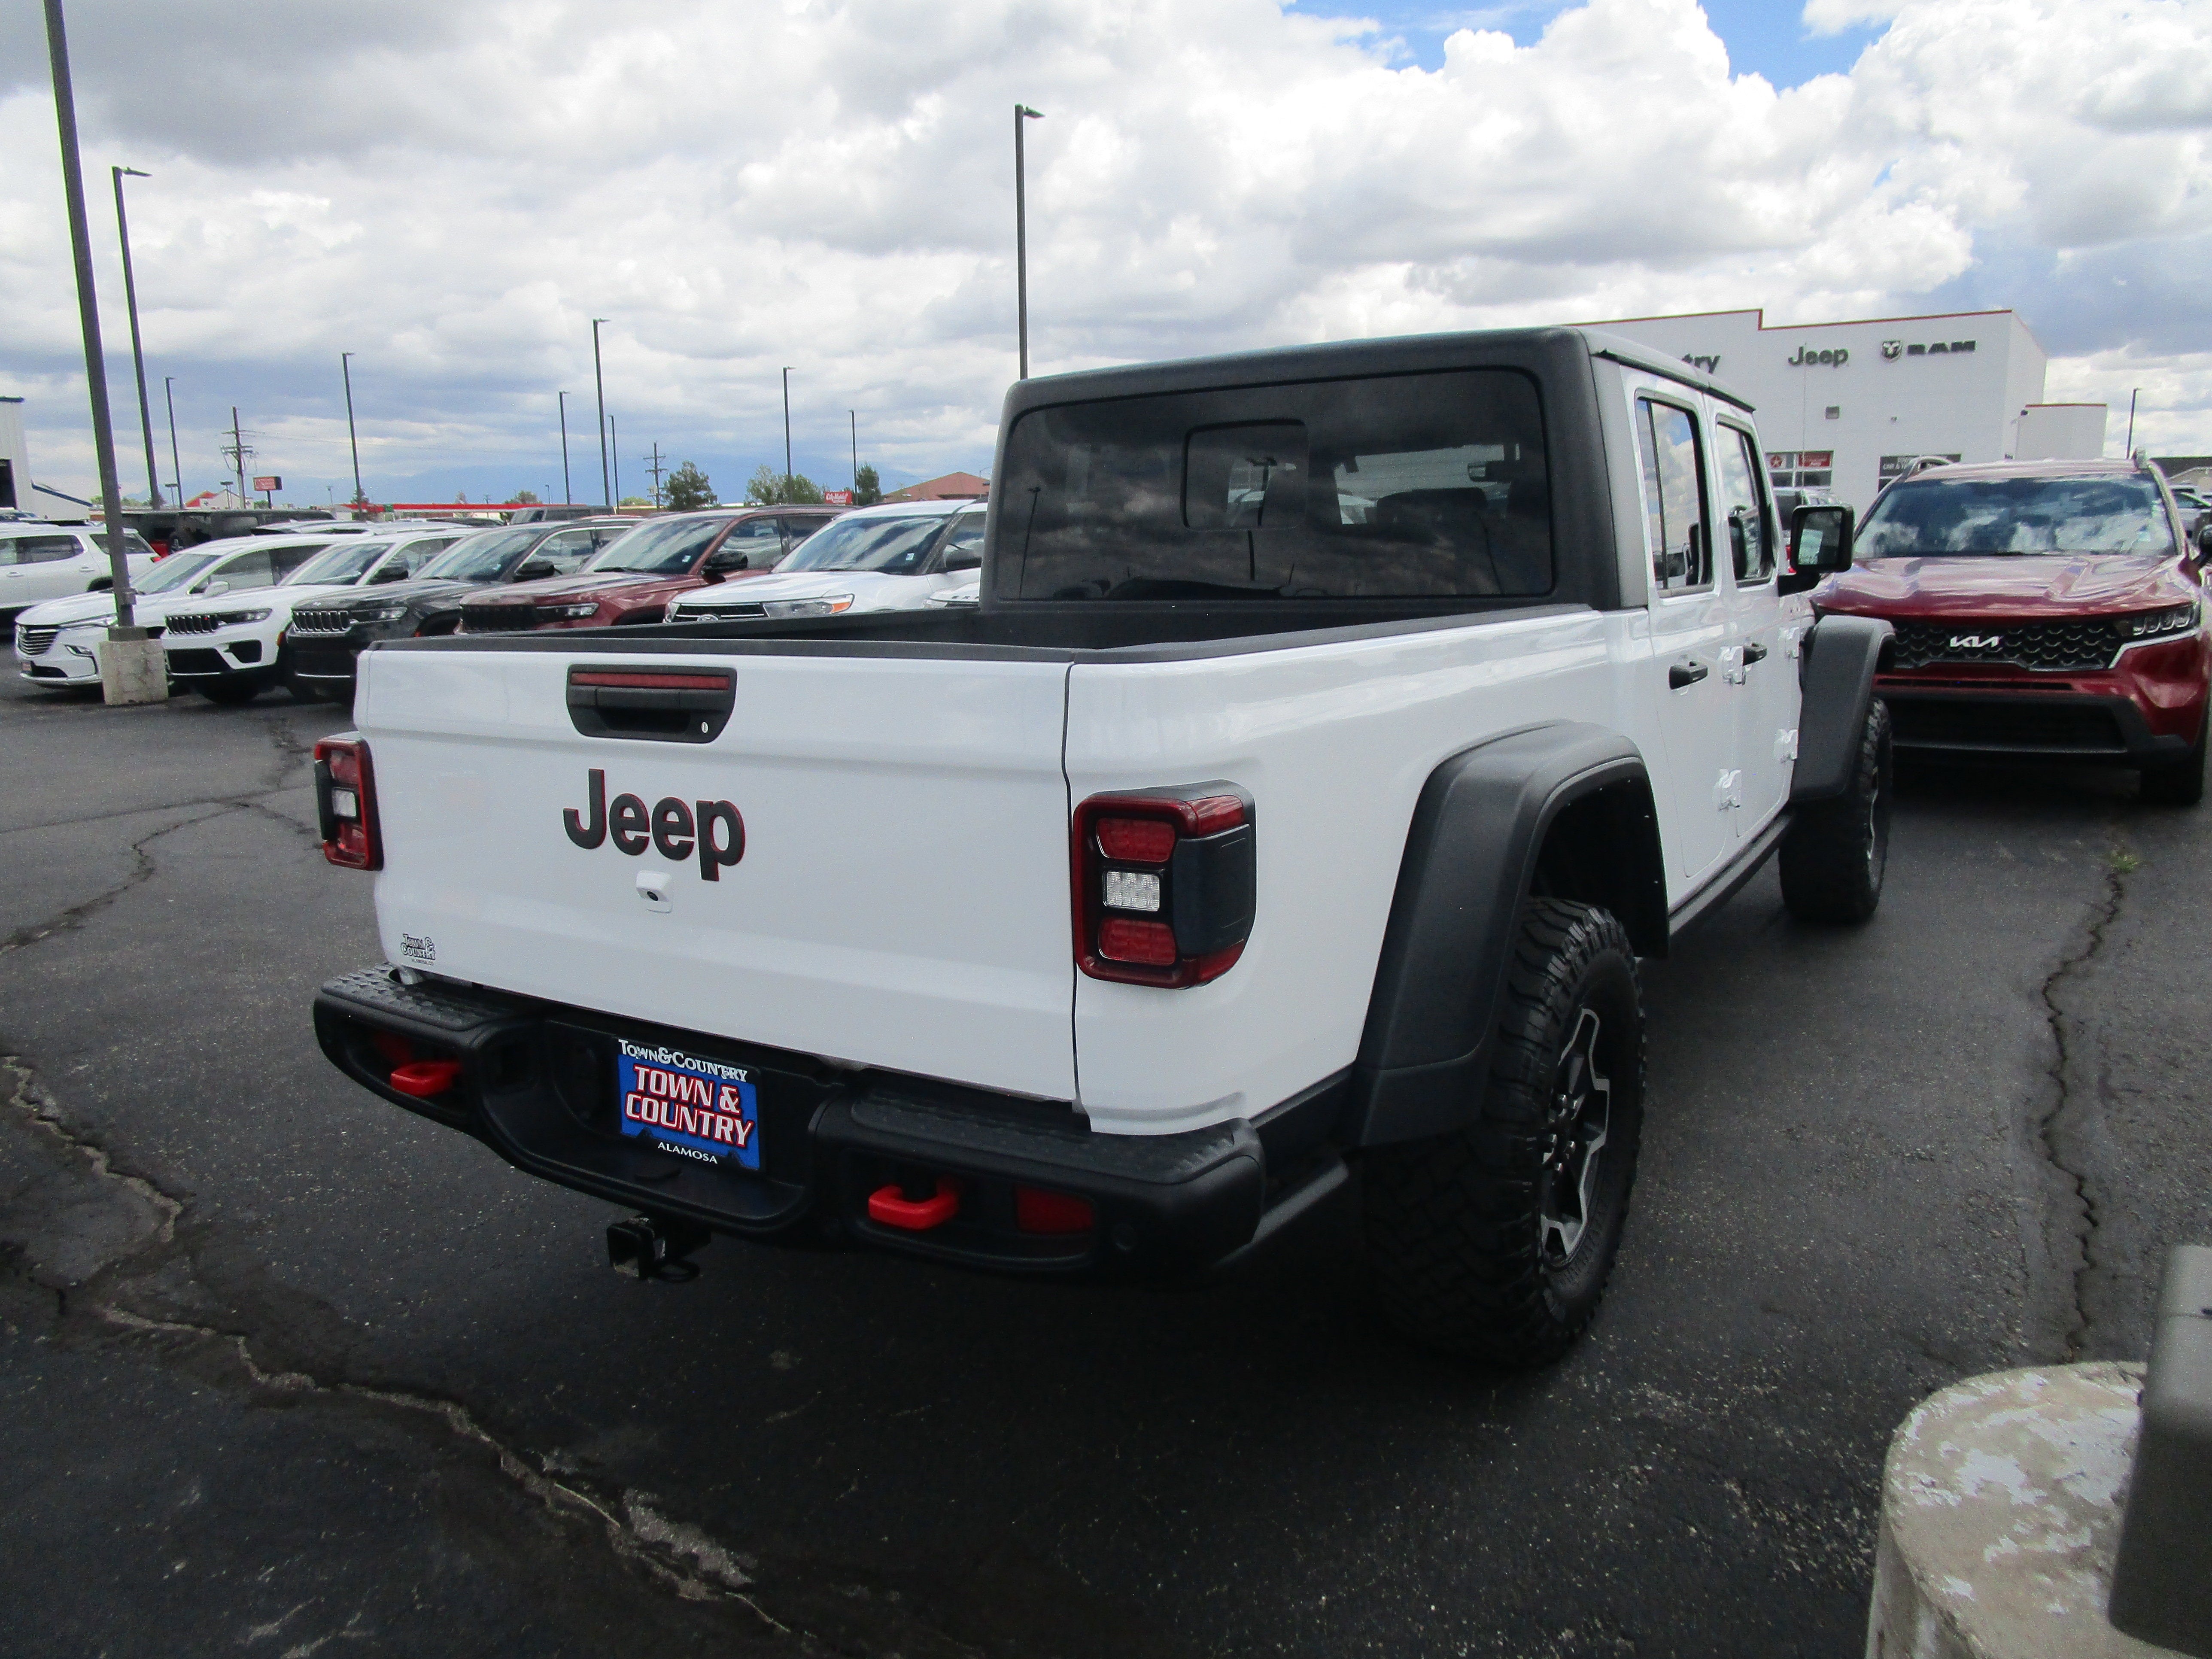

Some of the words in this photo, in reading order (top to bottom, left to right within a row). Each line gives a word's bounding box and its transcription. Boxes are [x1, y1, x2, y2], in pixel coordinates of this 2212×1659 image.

[1788, 346, 1849, 368] Jeep
[1907, 340, 1976, 355] RAM
[1950, 635, 1999, 647] KIA
[563, 768, 745, 881] Jeep
[633, 1064, 714, 1108] TOWN
[718, 1084, 741, 1115] &
[625, 1092, 754, 1147] COUNTRY
[657, 1142, 718, 1164] ALAMOSA
